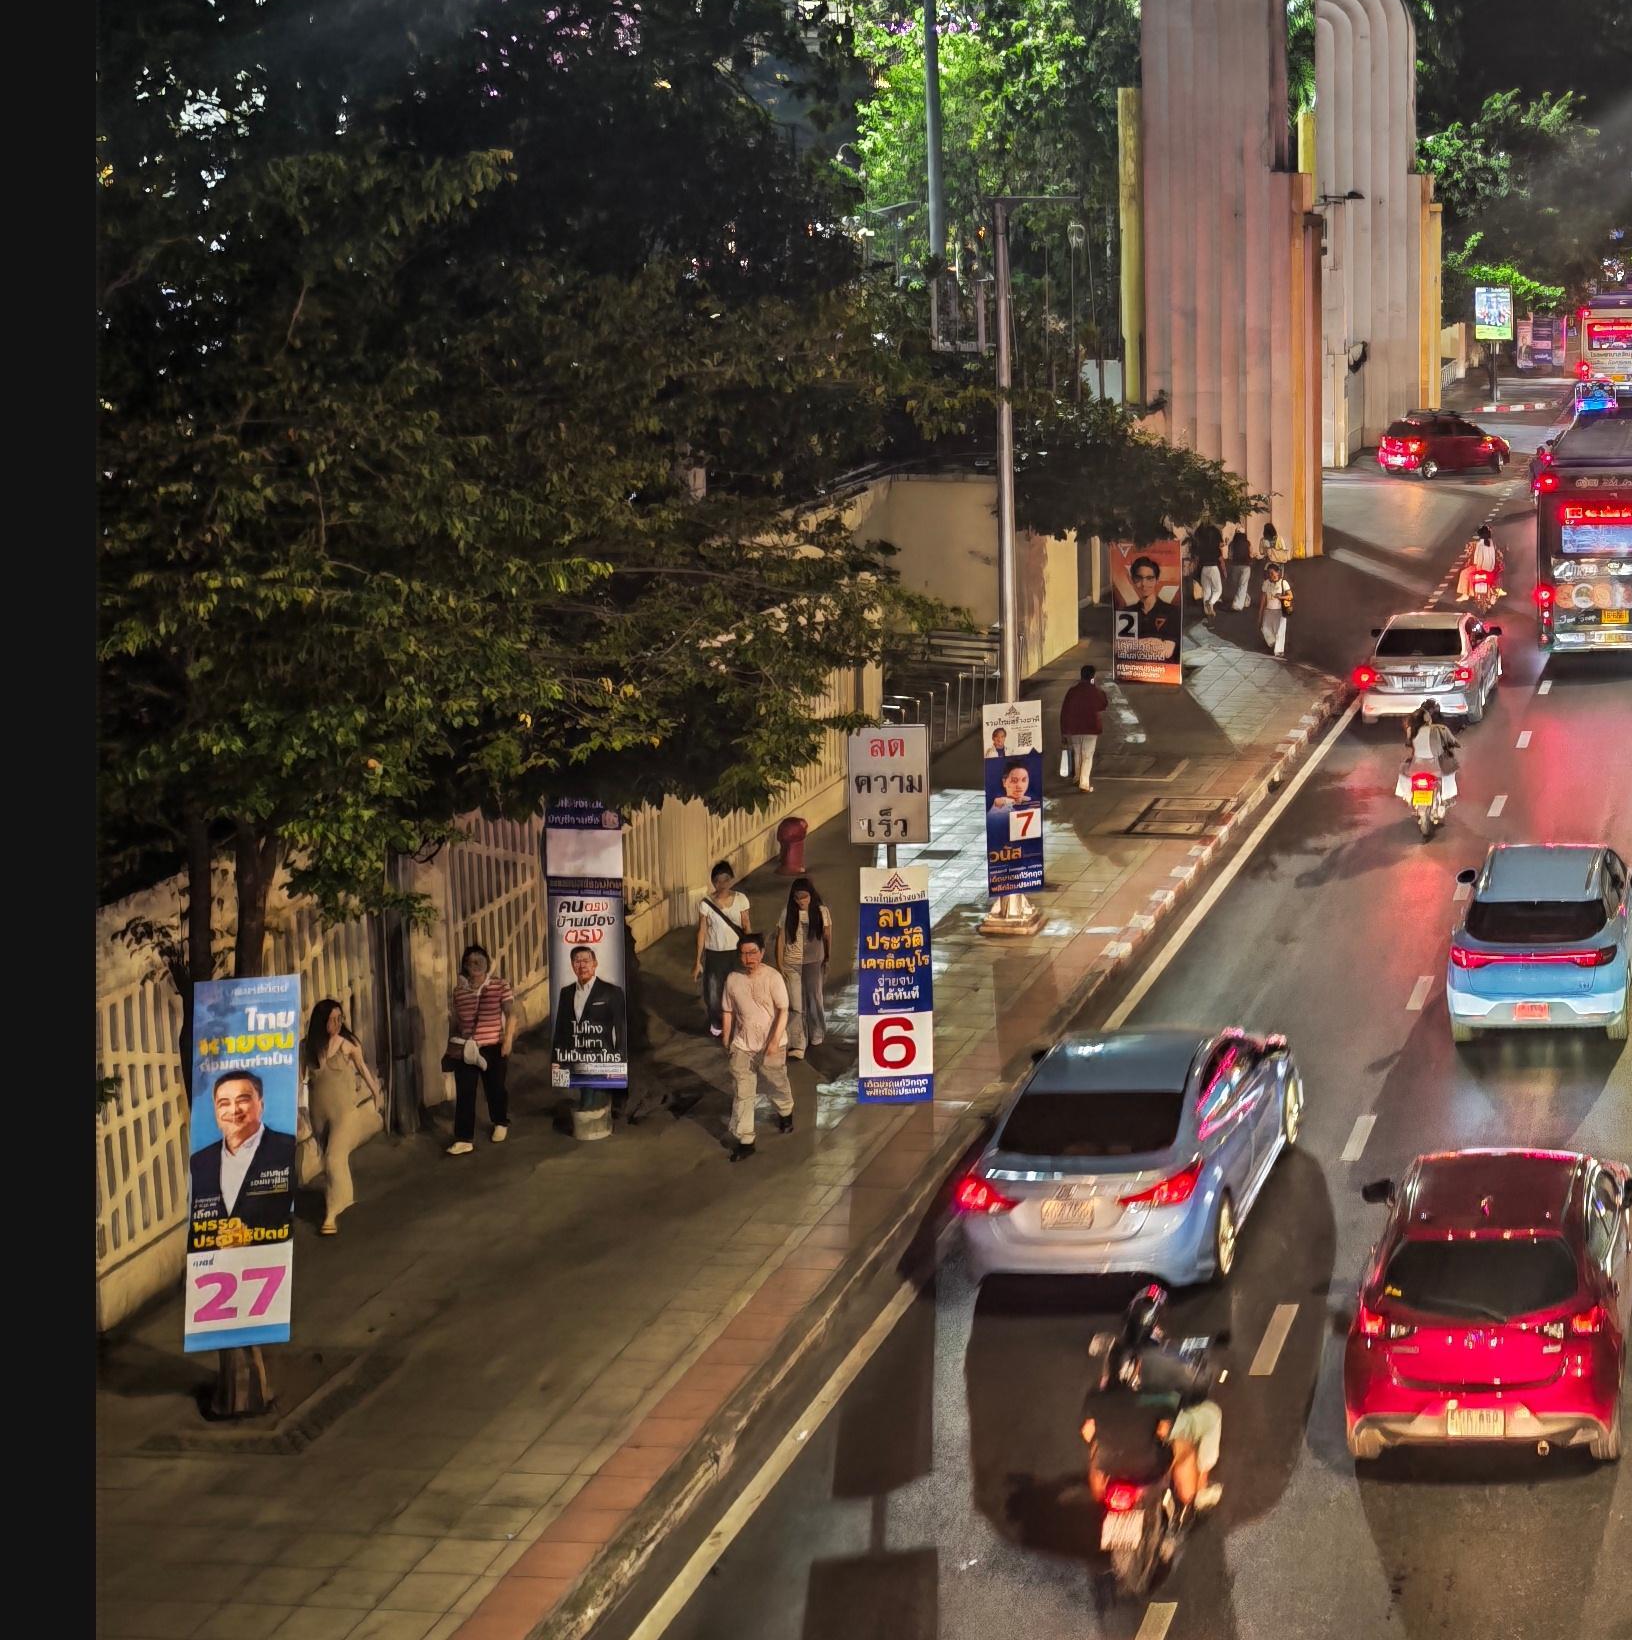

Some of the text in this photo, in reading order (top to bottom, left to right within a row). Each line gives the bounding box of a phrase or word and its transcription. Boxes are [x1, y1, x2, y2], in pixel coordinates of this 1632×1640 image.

[1118, 614, 1136, 638] 2
[869, 738, 905, 757] ลด
[854, 774, 923, 794] ความ
[867, 808, 908, 838] เร็ว
[1016, 811, 1035, 837] 7
[556, 913, 616, 927] บ้านเมือง
[878, 907, 912, 928] ลบ
[564, 928, 605, 944] ตรง
[866, 926, 925, 950] ประวัติ
[861, 950, 930, 973] เครดิตบูโร
[877, 974, 914, 987] จ่ายจบ
[872, 985, 920, 1006] กู้ได้ทันที
[245, 1006, 295, 1032] ไทย
[571, 1020, 603, 1034] ไม่โกง
[572, 1034, 603, 1048] ไม่เทา
[873, 1017, 917, 1069] 6
[193, 1265, 286, 1323] 27
